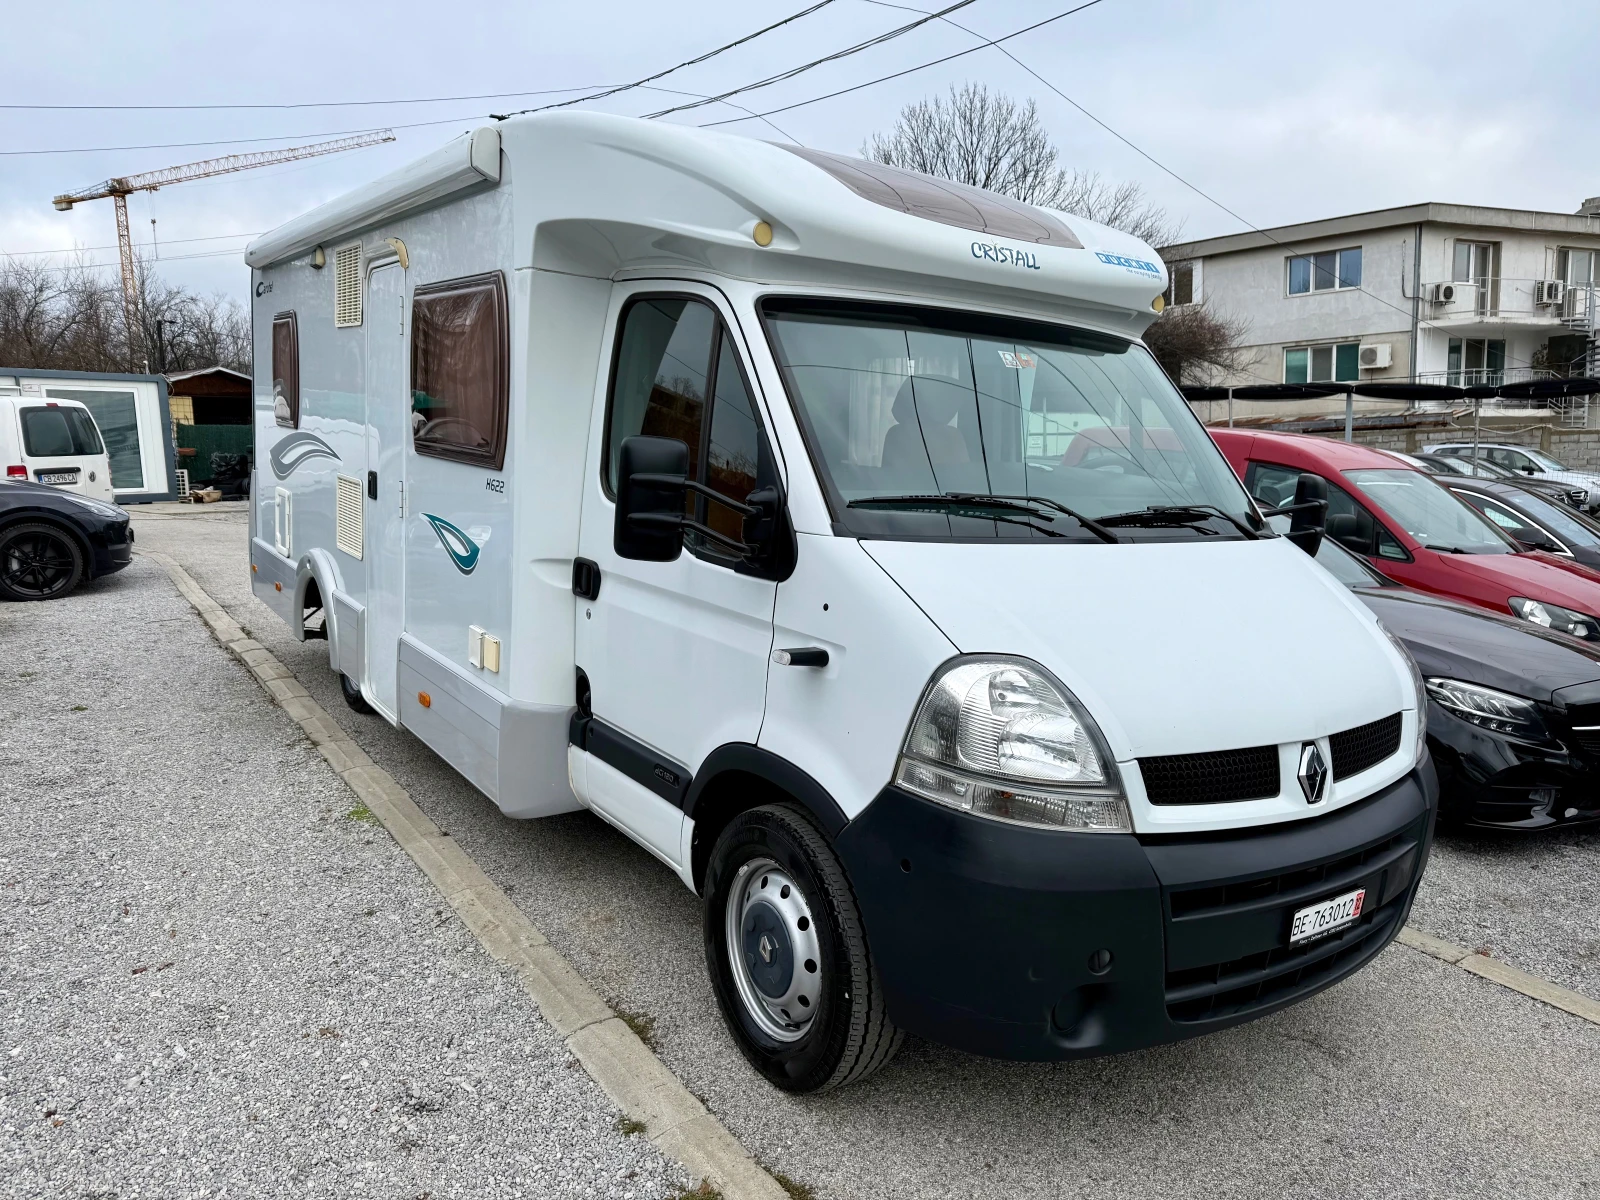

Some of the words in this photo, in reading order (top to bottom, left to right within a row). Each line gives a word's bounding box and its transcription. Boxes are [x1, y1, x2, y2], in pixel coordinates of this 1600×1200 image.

[971, 242, 1040, 269] CRISTALL
[1095, 252, 1159, 273] RUCHTI
[485, 477, 505, 494] H622
